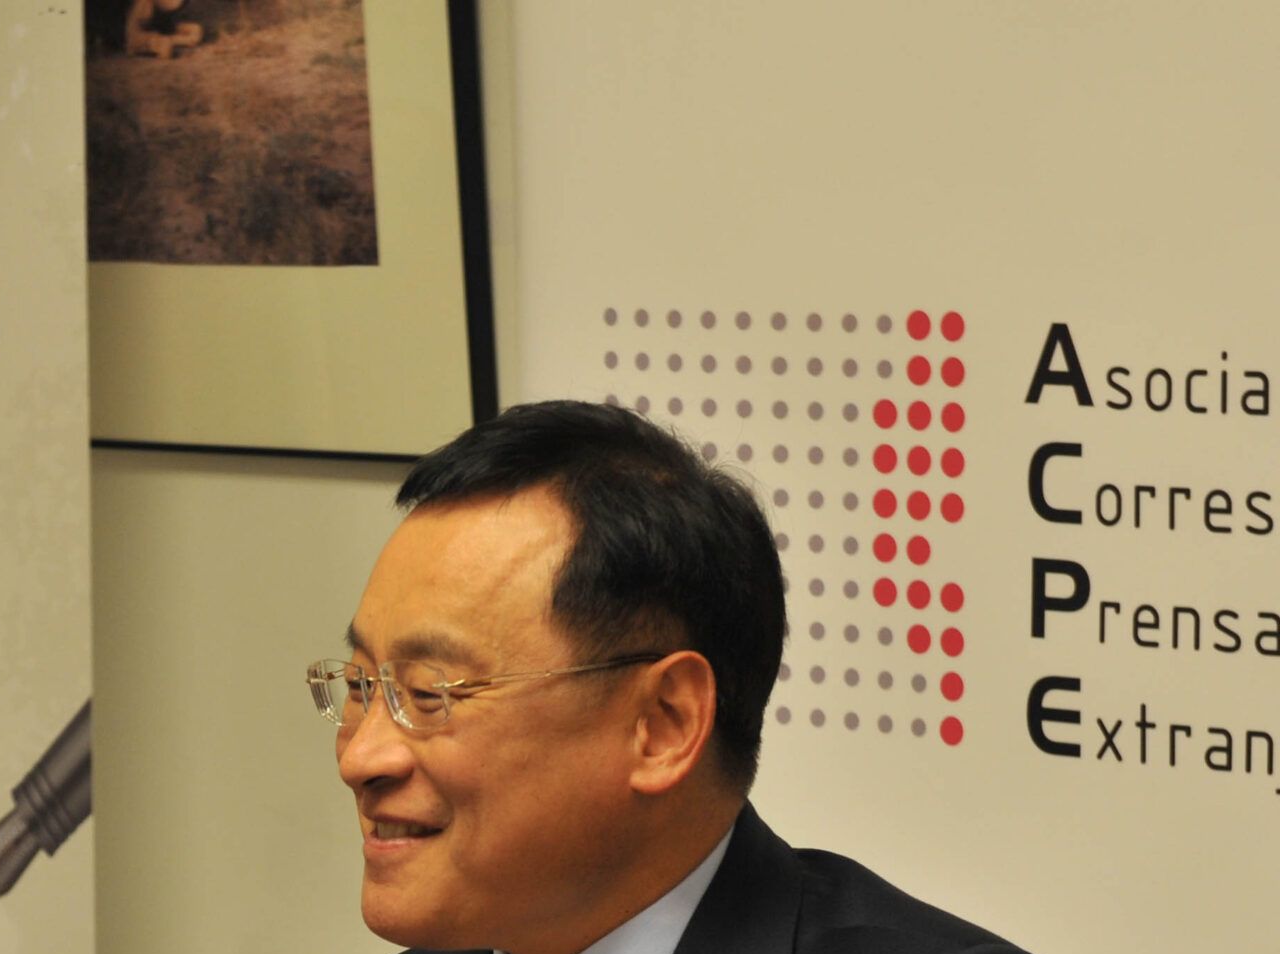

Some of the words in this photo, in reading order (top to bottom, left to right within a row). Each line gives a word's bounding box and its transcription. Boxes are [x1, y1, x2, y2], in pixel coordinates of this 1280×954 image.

[1027, 441, 1274, 536] Corres
[1030, 557, 1280, 657] Prensa
[1026, 675, 1280, 795] Extran
